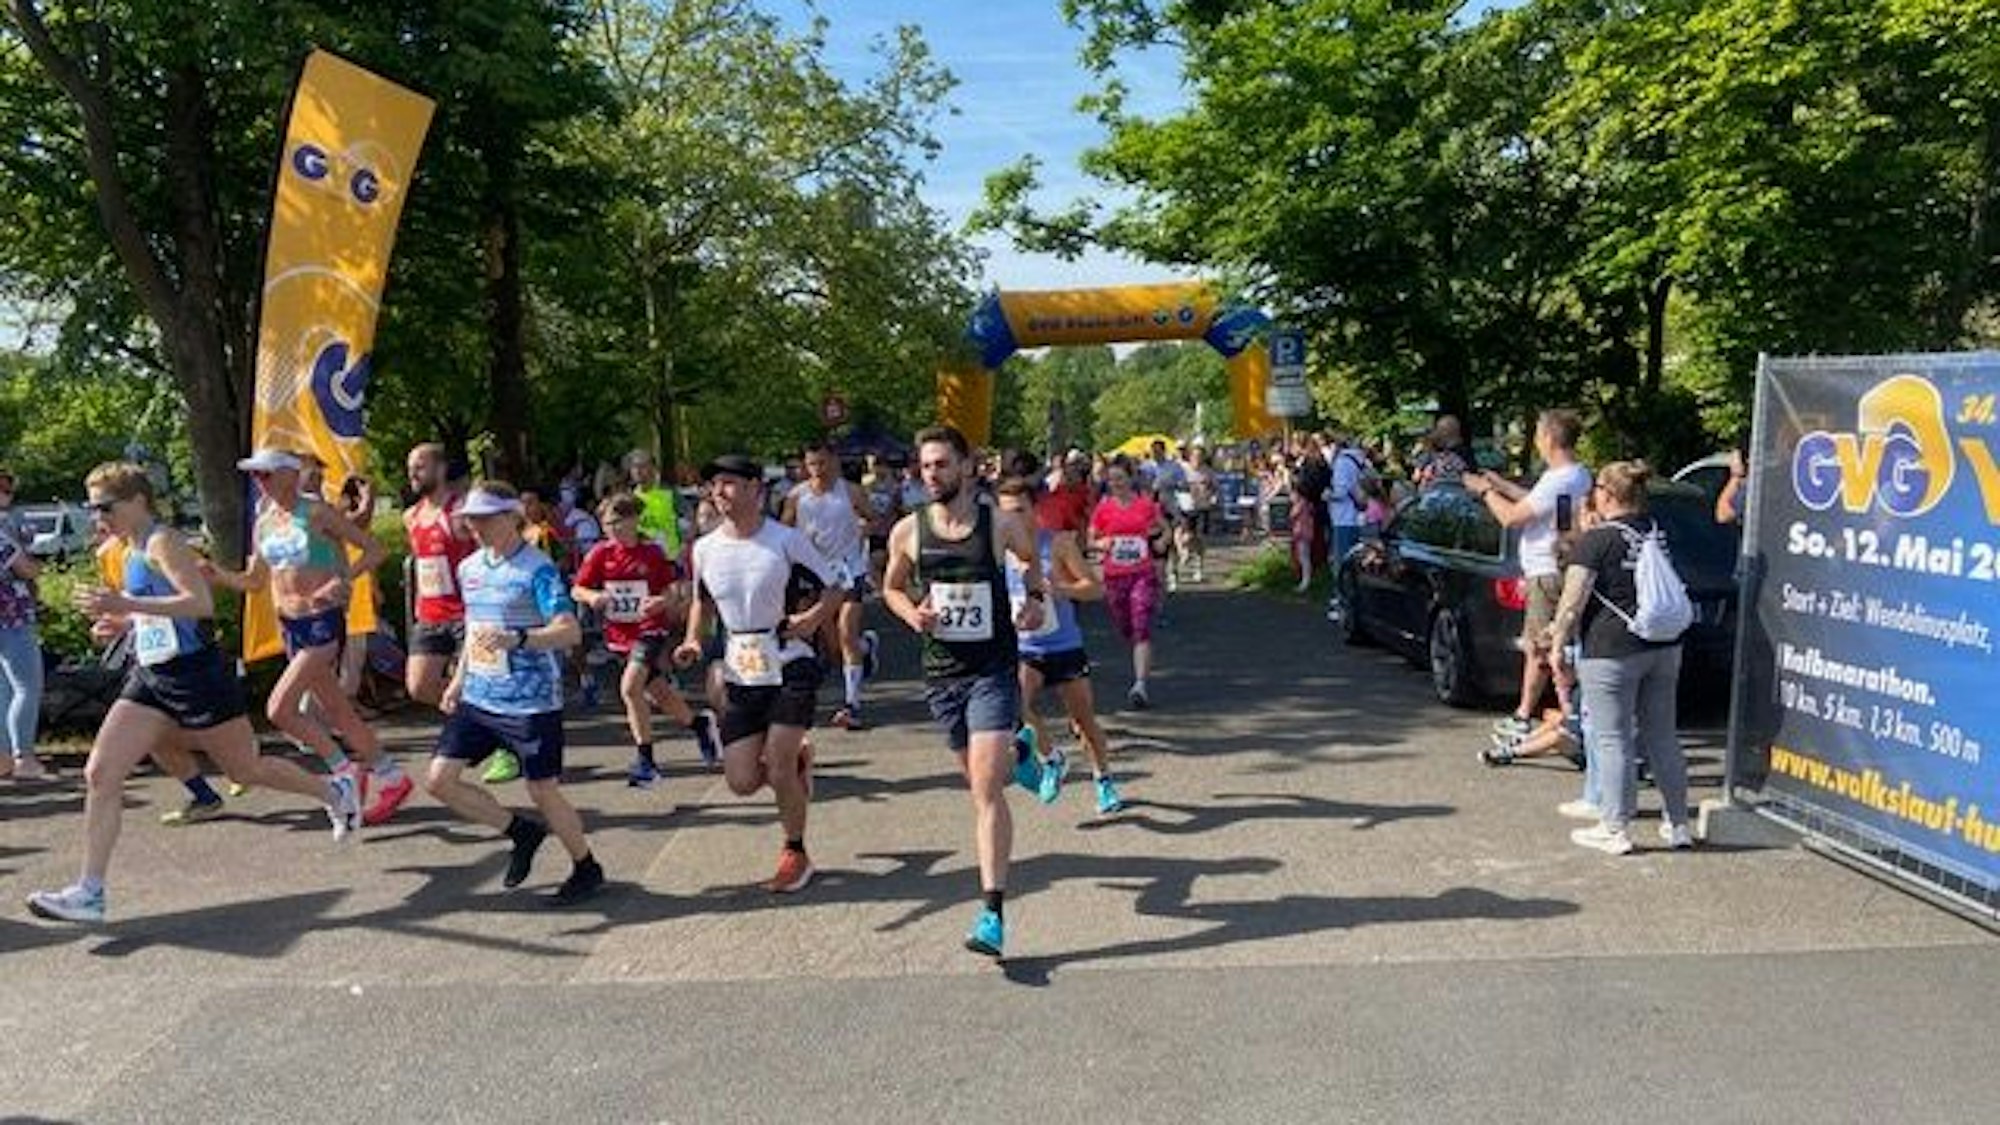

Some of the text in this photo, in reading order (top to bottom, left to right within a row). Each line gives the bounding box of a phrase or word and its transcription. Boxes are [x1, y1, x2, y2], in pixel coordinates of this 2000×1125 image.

[1276, 336, 1297, 364] P
[1793, 428, 1954, 517] GVG
[1788, 522, 1835, 558] So.
[1842, 528, 1890, 566] 12.
[1893, 534, 1963, 577] Mai
[940, 606, 982, 628] 373
[1783, 583, 1816, 614] Start
[1823, 692, 1836, 721] 5
[1869, 704, 1894, 741] 1,3
[1929, 721, 1961, 758] 500
[1962, 738, 1981, 764] m
